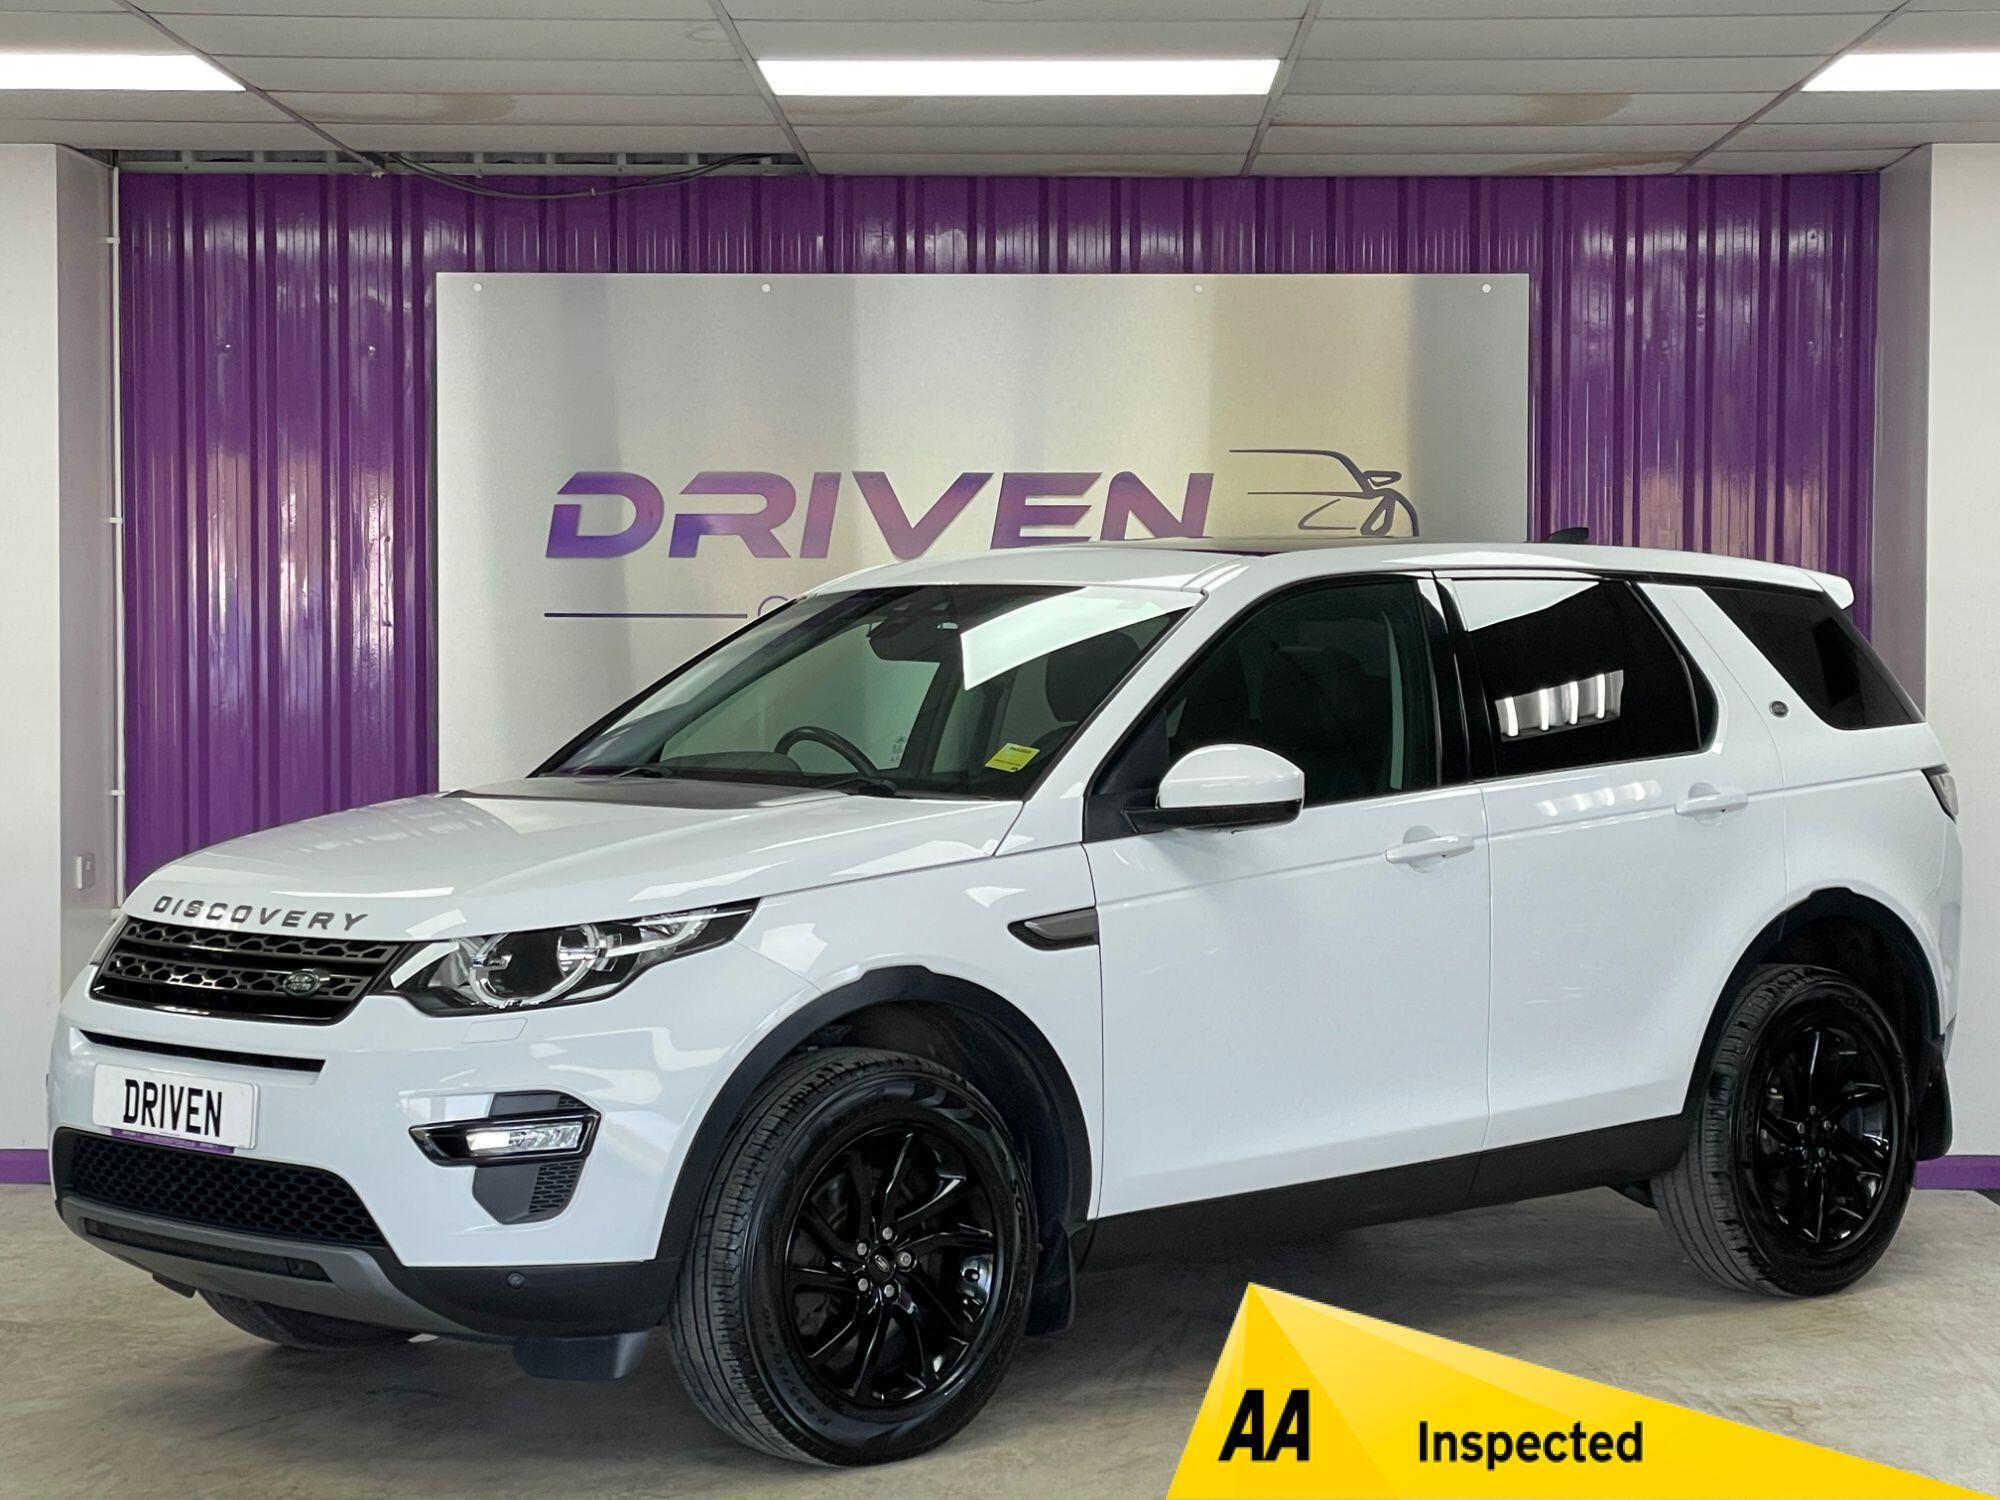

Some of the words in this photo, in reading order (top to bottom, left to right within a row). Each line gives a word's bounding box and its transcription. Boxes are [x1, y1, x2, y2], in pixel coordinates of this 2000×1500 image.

[545, 471, 1213, 558] DRIVEN
[153, 895, 368, 931] DISCOVERY
[123, 1078, 222, 1138] DRIVEN
